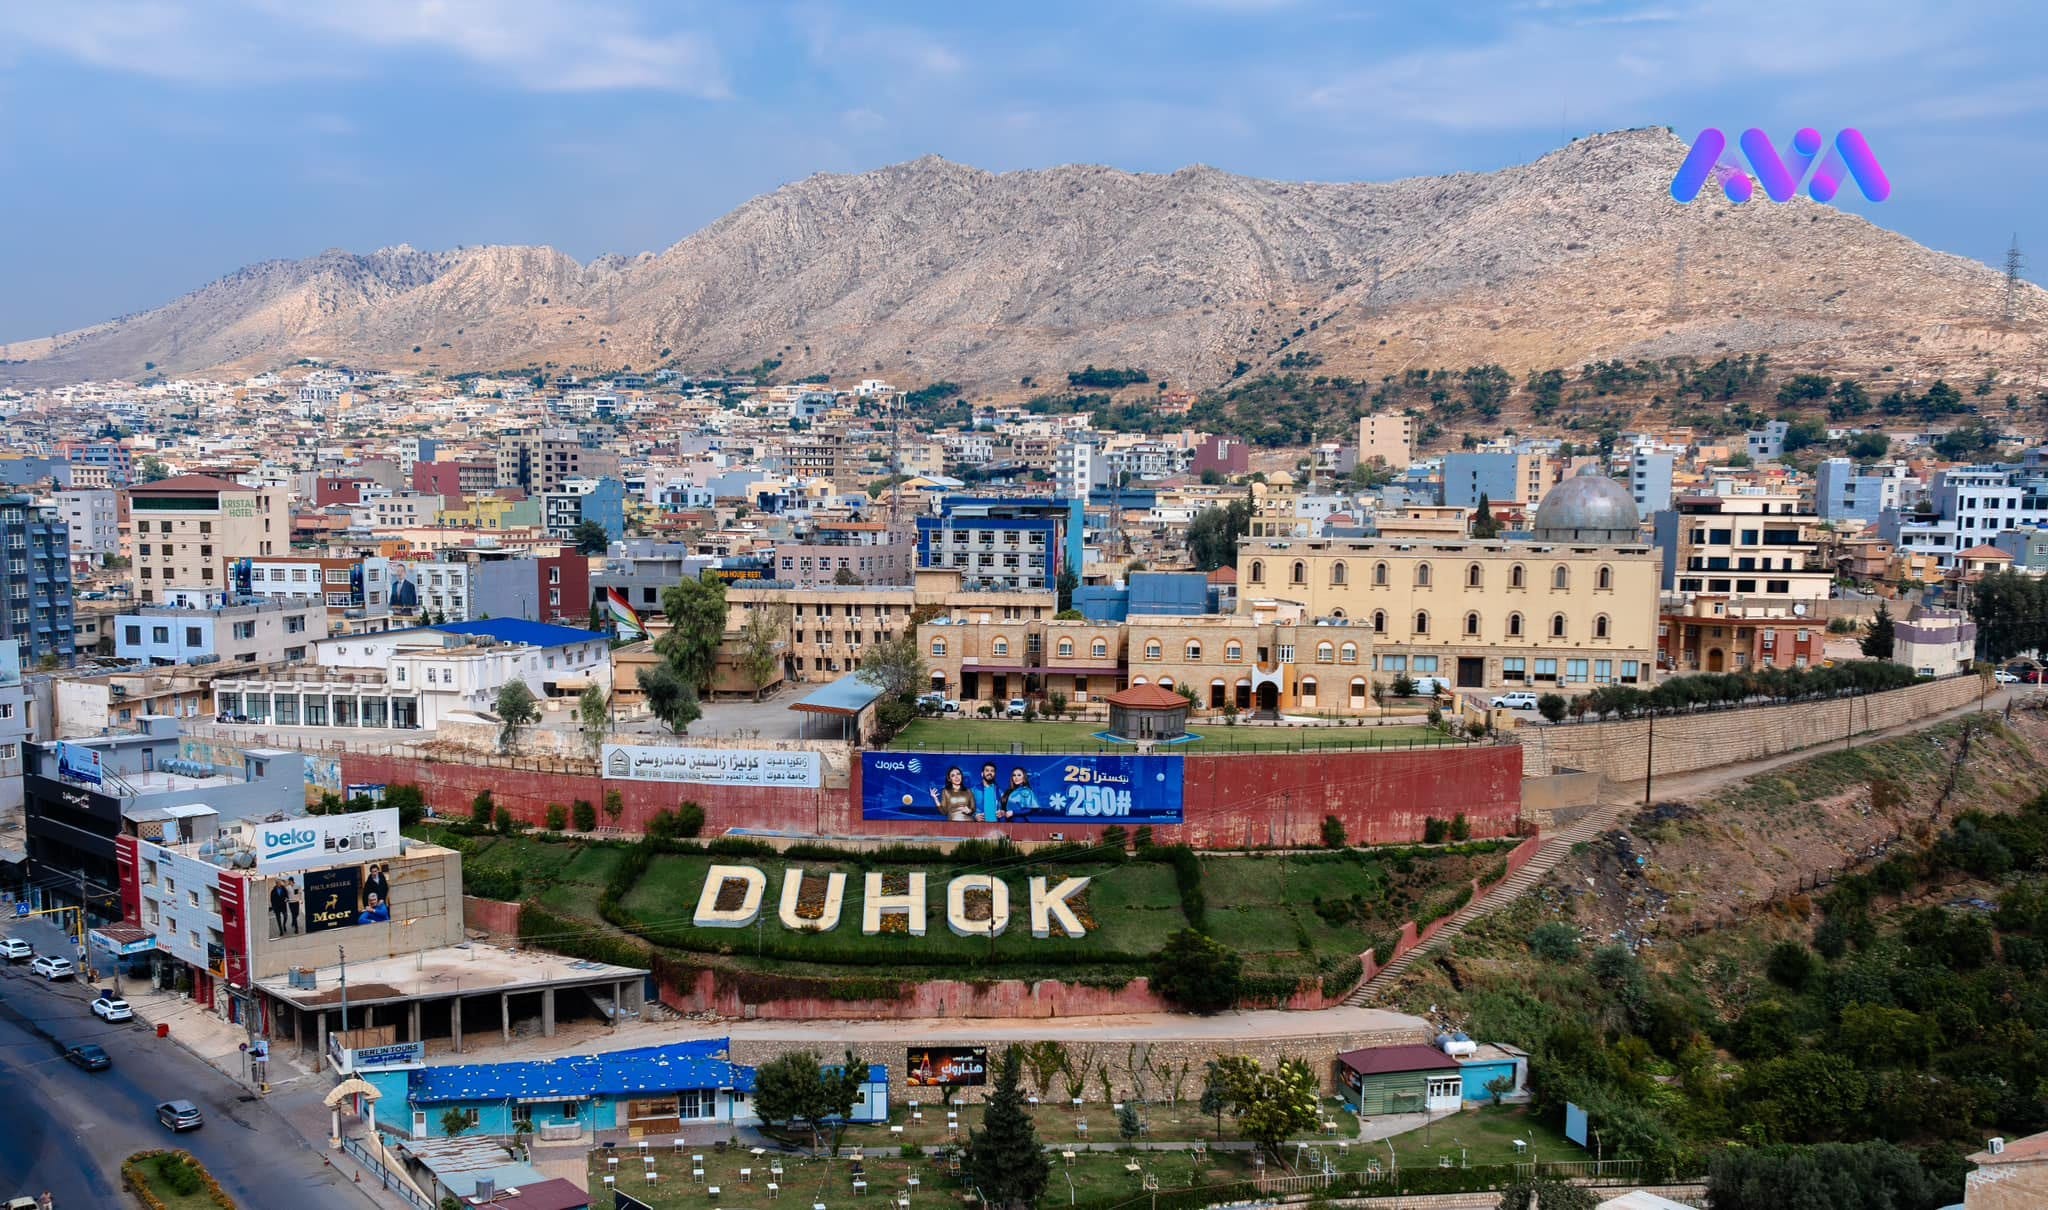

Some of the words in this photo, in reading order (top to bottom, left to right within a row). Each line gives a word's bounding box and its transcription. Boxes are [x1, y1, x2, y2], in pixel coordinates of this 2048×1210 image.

[229, 509, 253, 517] HOTEL
[1063, 765, 1091, 782] 25
[265, 828, 316, 848] beko
[693, 864, 1091, 939] DUHOK
[312, 910, 351, 922] Meer
[358, 1046, 389, 1057] BERLIN
[390, 1043, 418, 1053] TOURS
